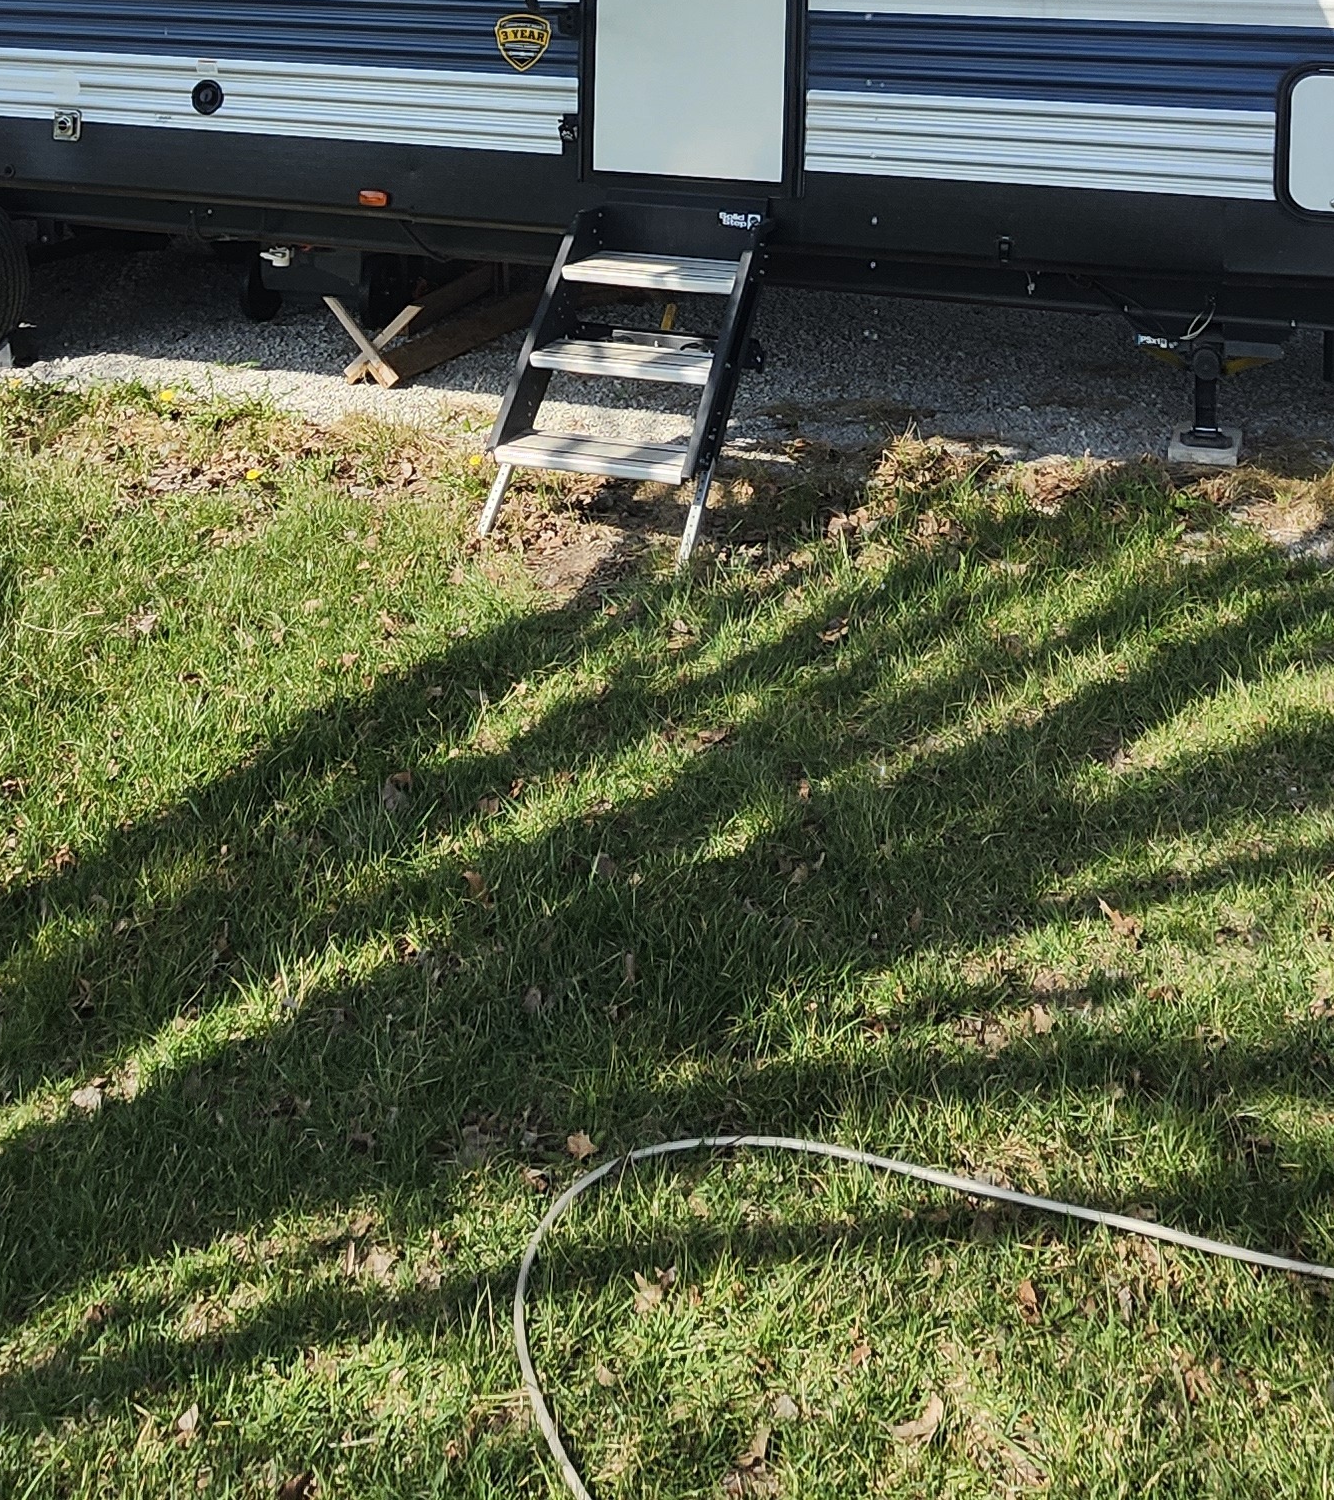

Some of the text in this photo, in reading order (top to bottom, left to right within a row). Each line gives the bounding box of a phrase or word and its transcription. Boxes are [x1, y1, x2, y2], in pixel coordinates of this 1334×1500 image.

[501, 29, 545, 42] 3 YEAR
[719, 211, 745, 221] Solid
[722, 219, 747, 228] Step
